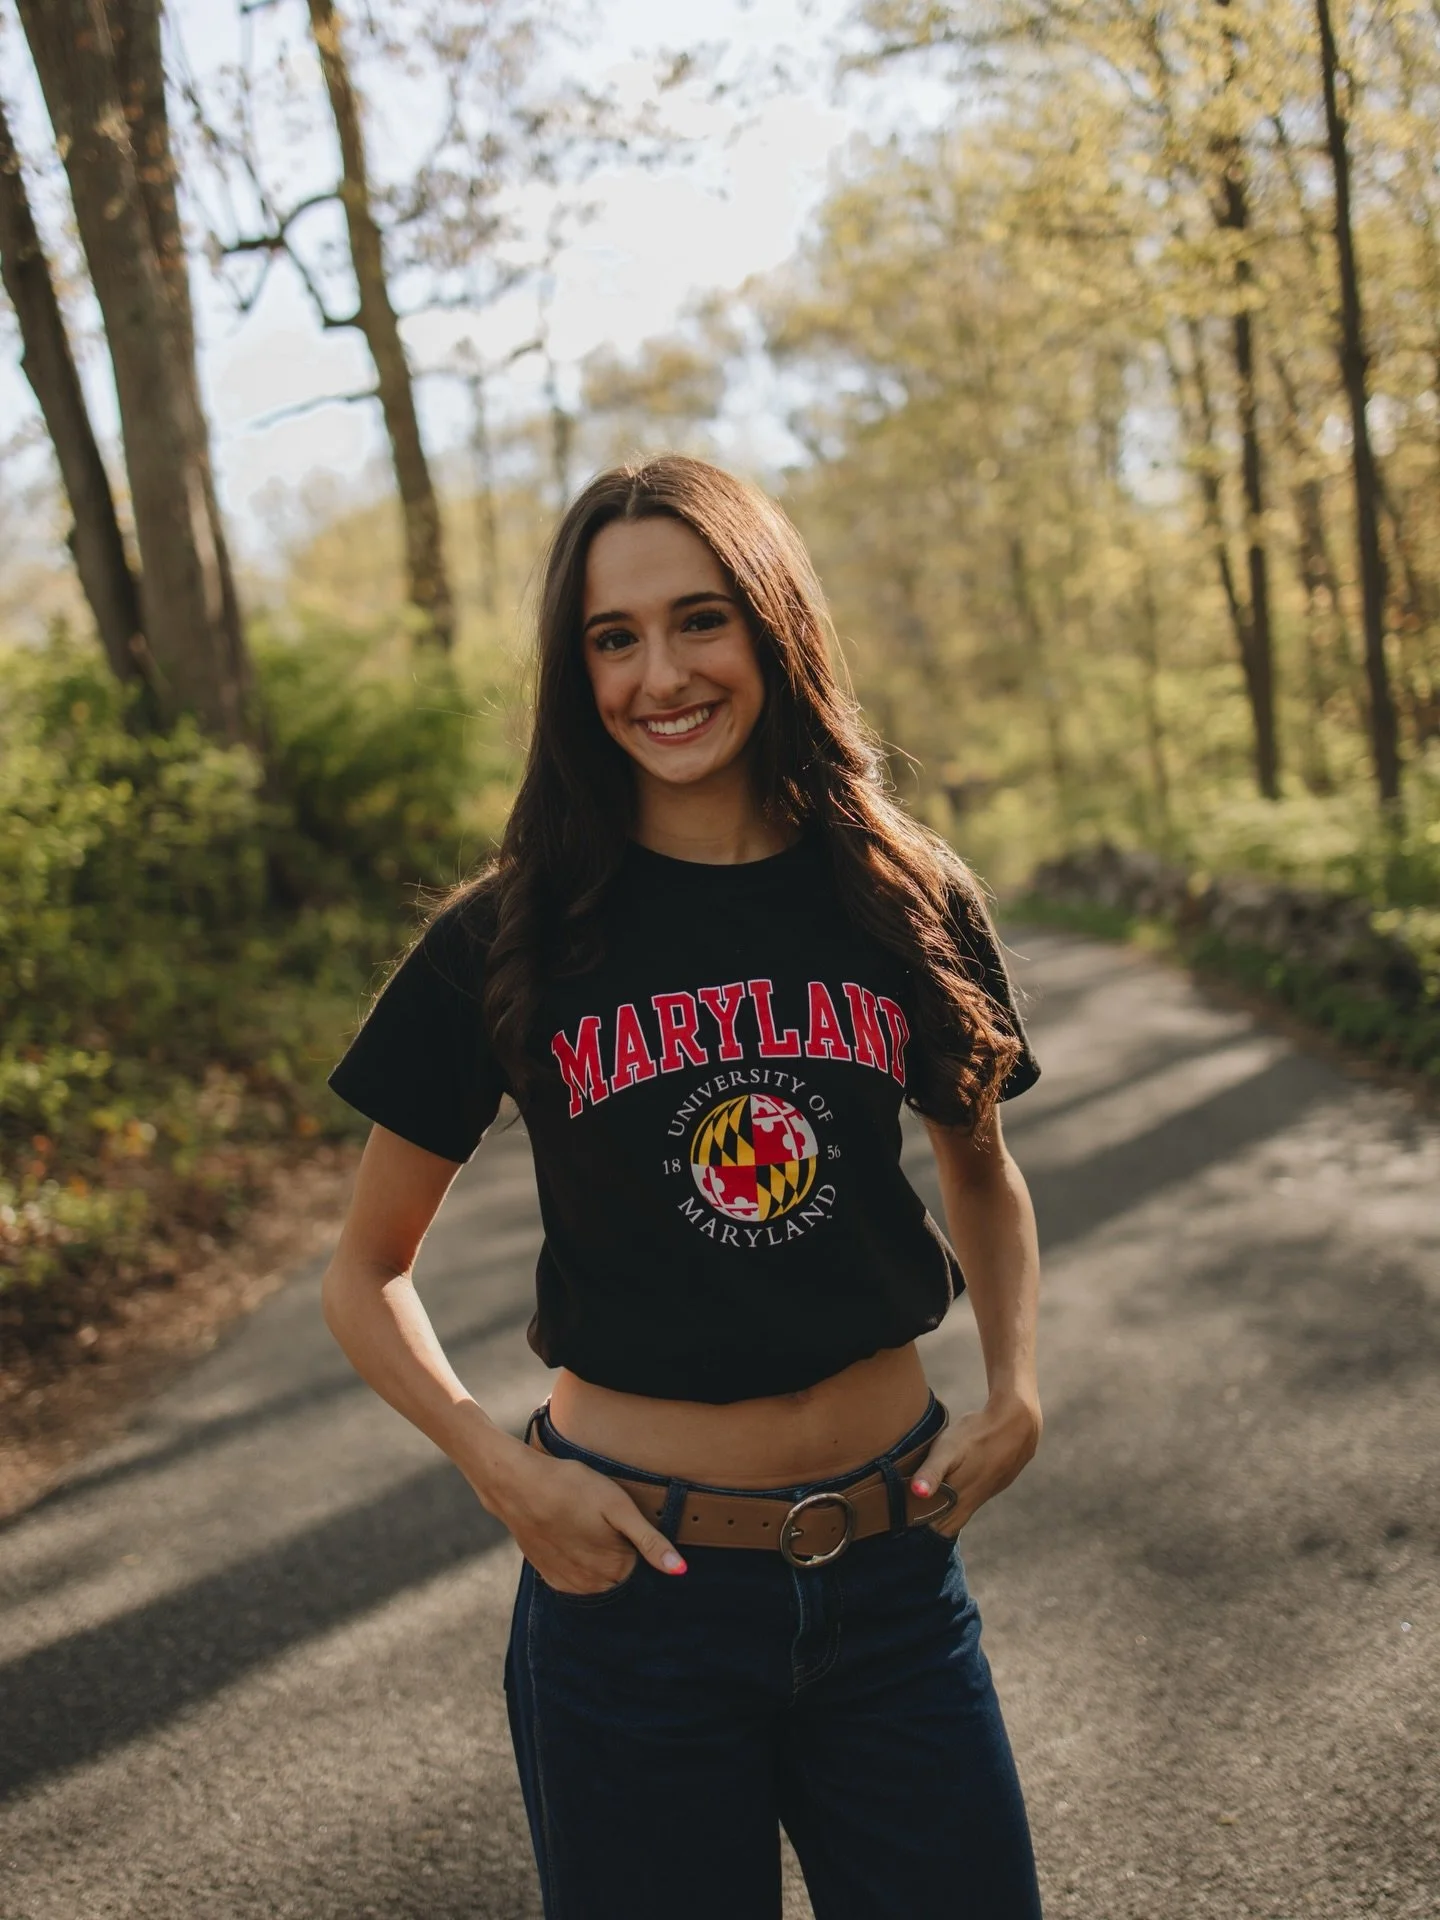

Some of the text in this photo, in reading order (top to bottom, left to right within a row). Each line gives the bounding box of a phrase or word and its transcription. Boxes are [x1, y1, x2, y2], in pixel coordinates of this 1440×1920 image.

[551, 979, 910, 1119] MARYLAND
[667, 1068, 834, 1137] UNIVERSITY OF
[662, 1145, 841, 1176] 18 56
[677, 1184, 836, 1248] MARYLAND
